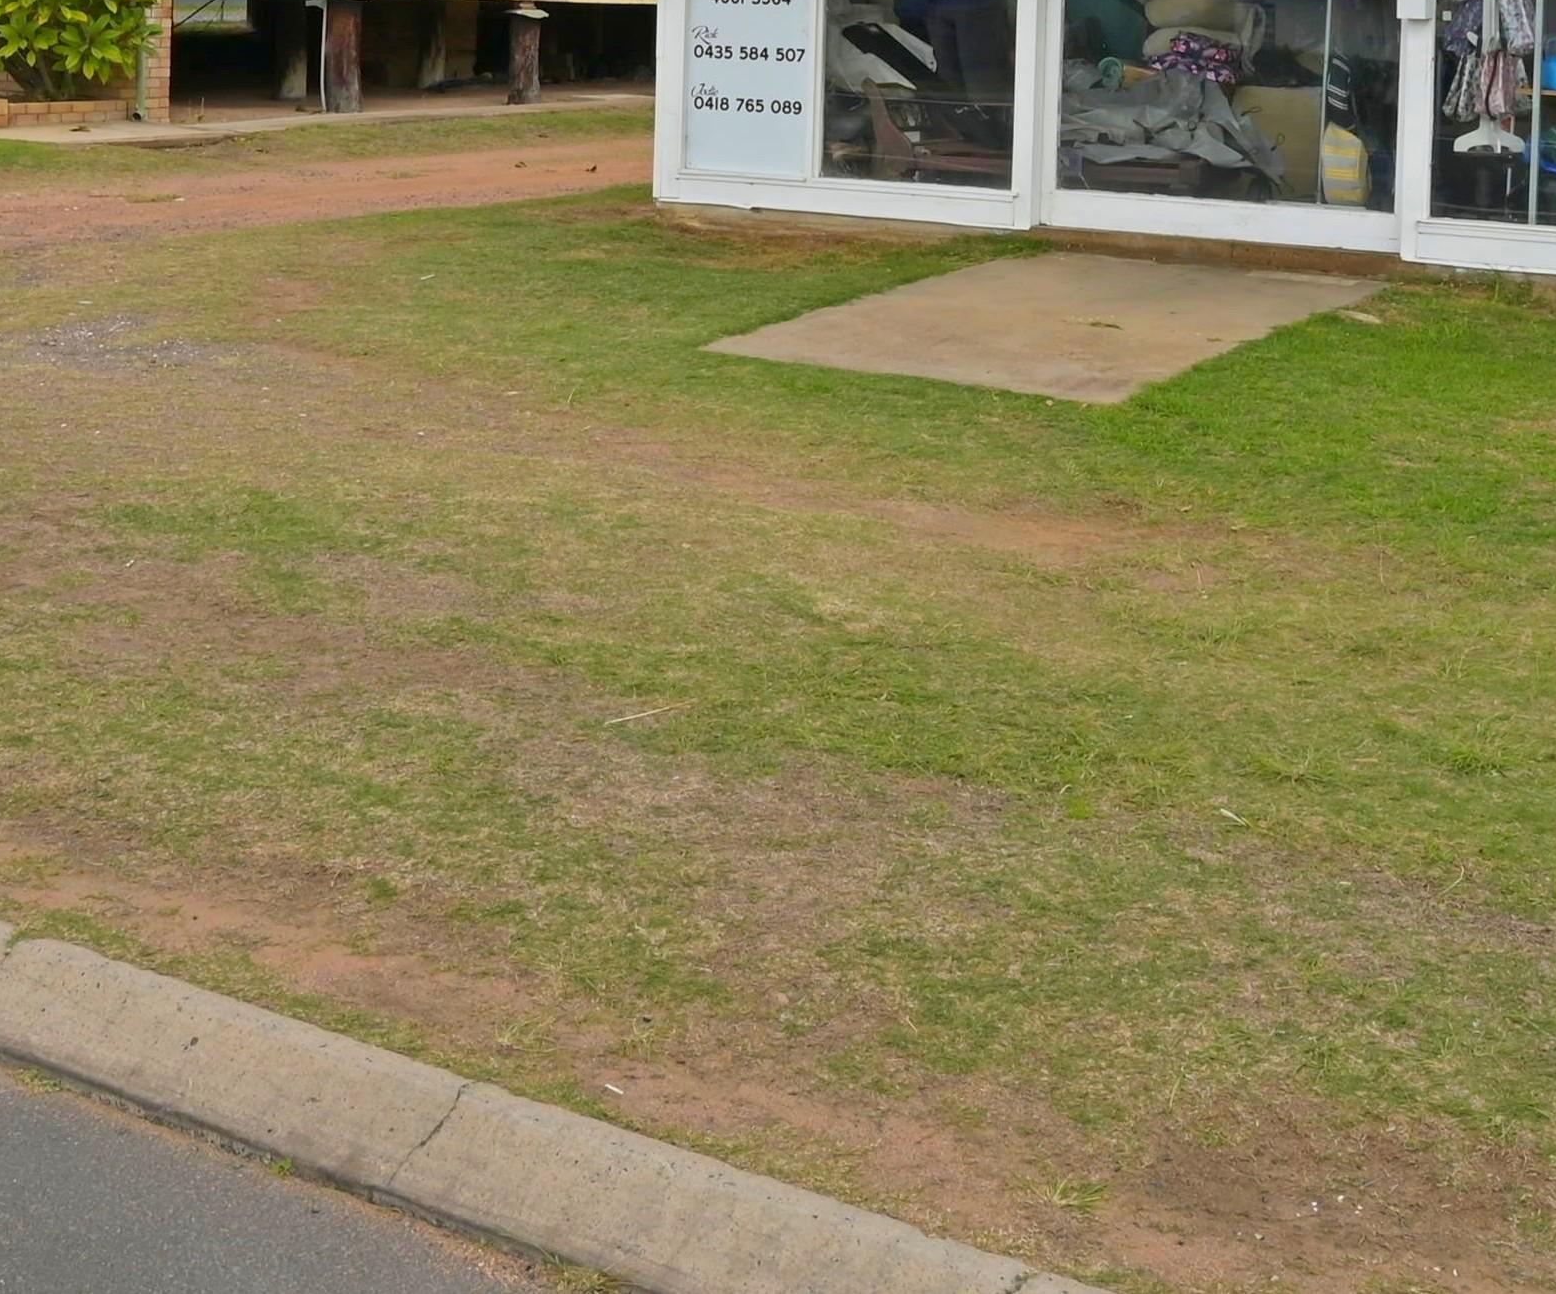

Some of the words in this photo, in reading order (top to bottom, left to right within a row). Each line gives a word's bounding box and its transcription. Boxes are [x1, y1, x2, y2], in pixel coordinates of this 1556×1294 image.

[693, 44, 734, 60] 0435
[739, 46, 770, 62] 584
[775, 47, 806, 63] 507
[693, 96, 730, 112] 0418
[736, 97, 765, 114] 765
[770, 99, 803, 116] 089
